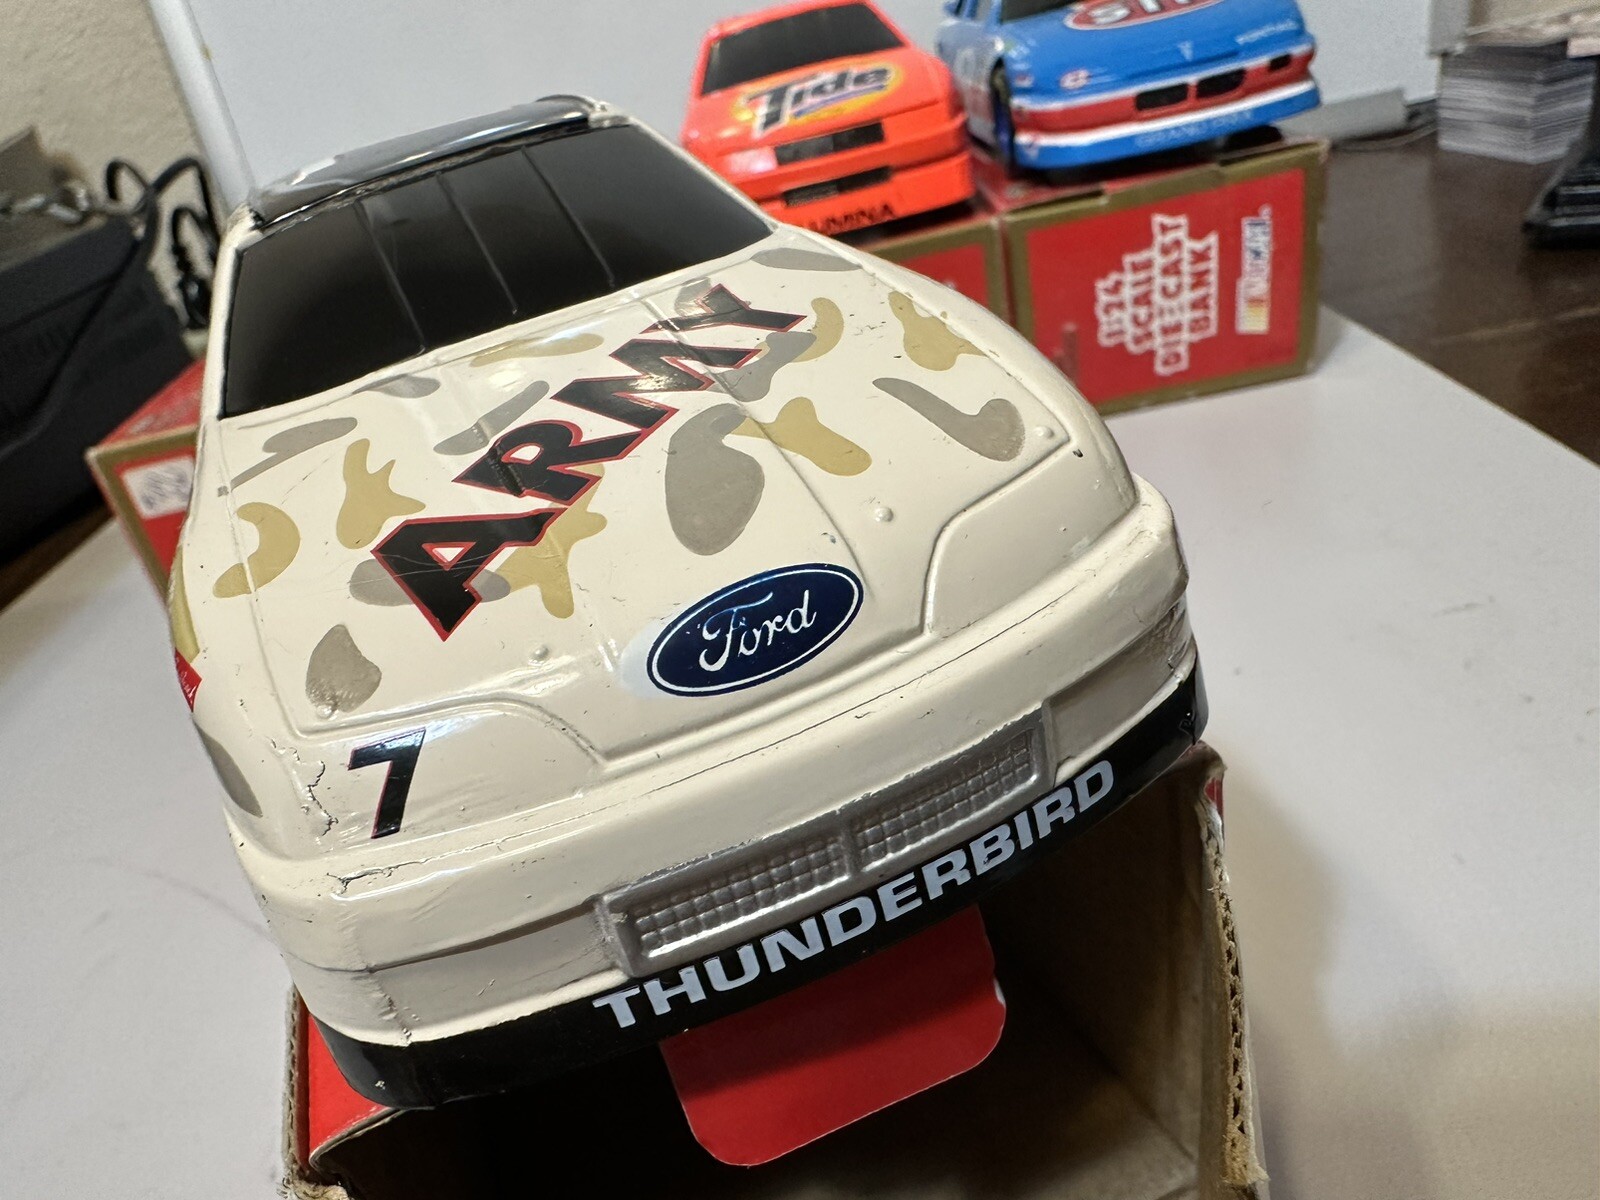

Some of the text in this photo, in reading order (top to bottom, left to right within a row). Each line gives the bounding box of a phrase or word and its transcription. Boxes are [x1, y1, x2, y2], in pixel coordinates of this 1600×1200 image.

[744, 66, 893, 136] Tide
[1125, 250, 1153, 352] SCALE
[1187, 234, 1216, 340] BANK
[371, 283, 807, 641] ARMY
[699, 589, 817, 672] Ford
[348, 727, 426, 838] 7
[593, 759, 1115, 1029] THUNDERBIRD
